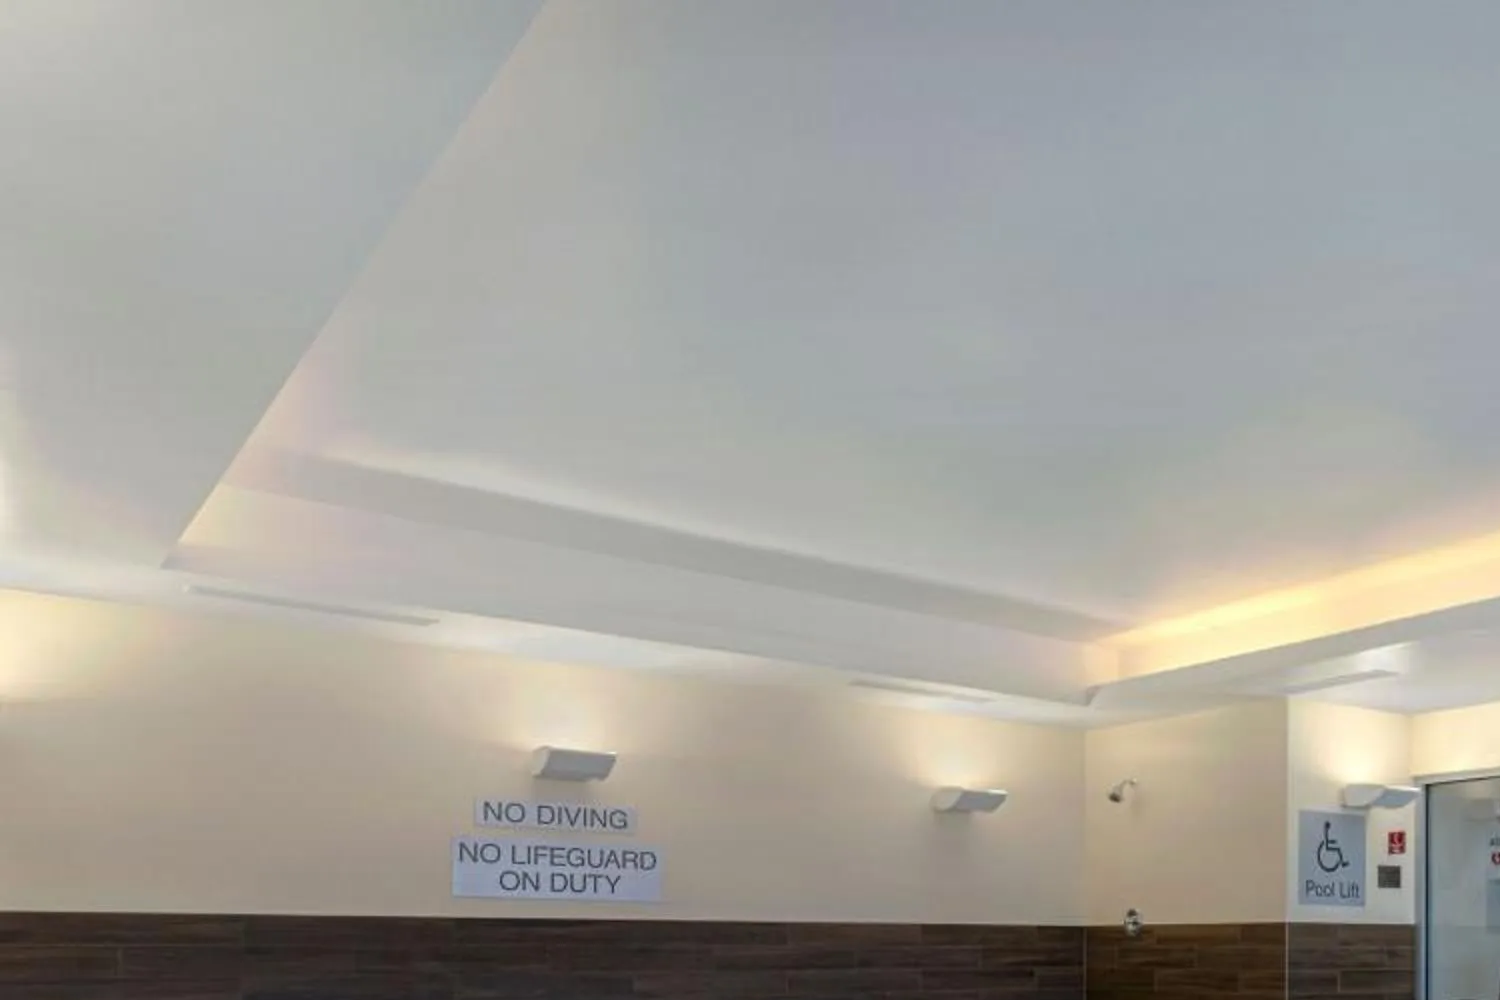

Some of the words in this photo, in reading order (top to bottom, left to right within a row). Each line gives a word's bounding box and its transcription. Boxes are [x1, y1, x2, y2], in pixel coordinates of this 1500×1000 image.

[483, 802, 526, 823] NO
[537, 805, 628, 830] DIVING
[459, 842, 501, 864] NO
[511, 844, 657, 871] LIFEGUARD
[499, 871, 540, 891] ON
[550, 873, 621, 894] DUTY
[1305, 880, 1335, 897] Pool
[1340, 881, 1360, 898] Lift
